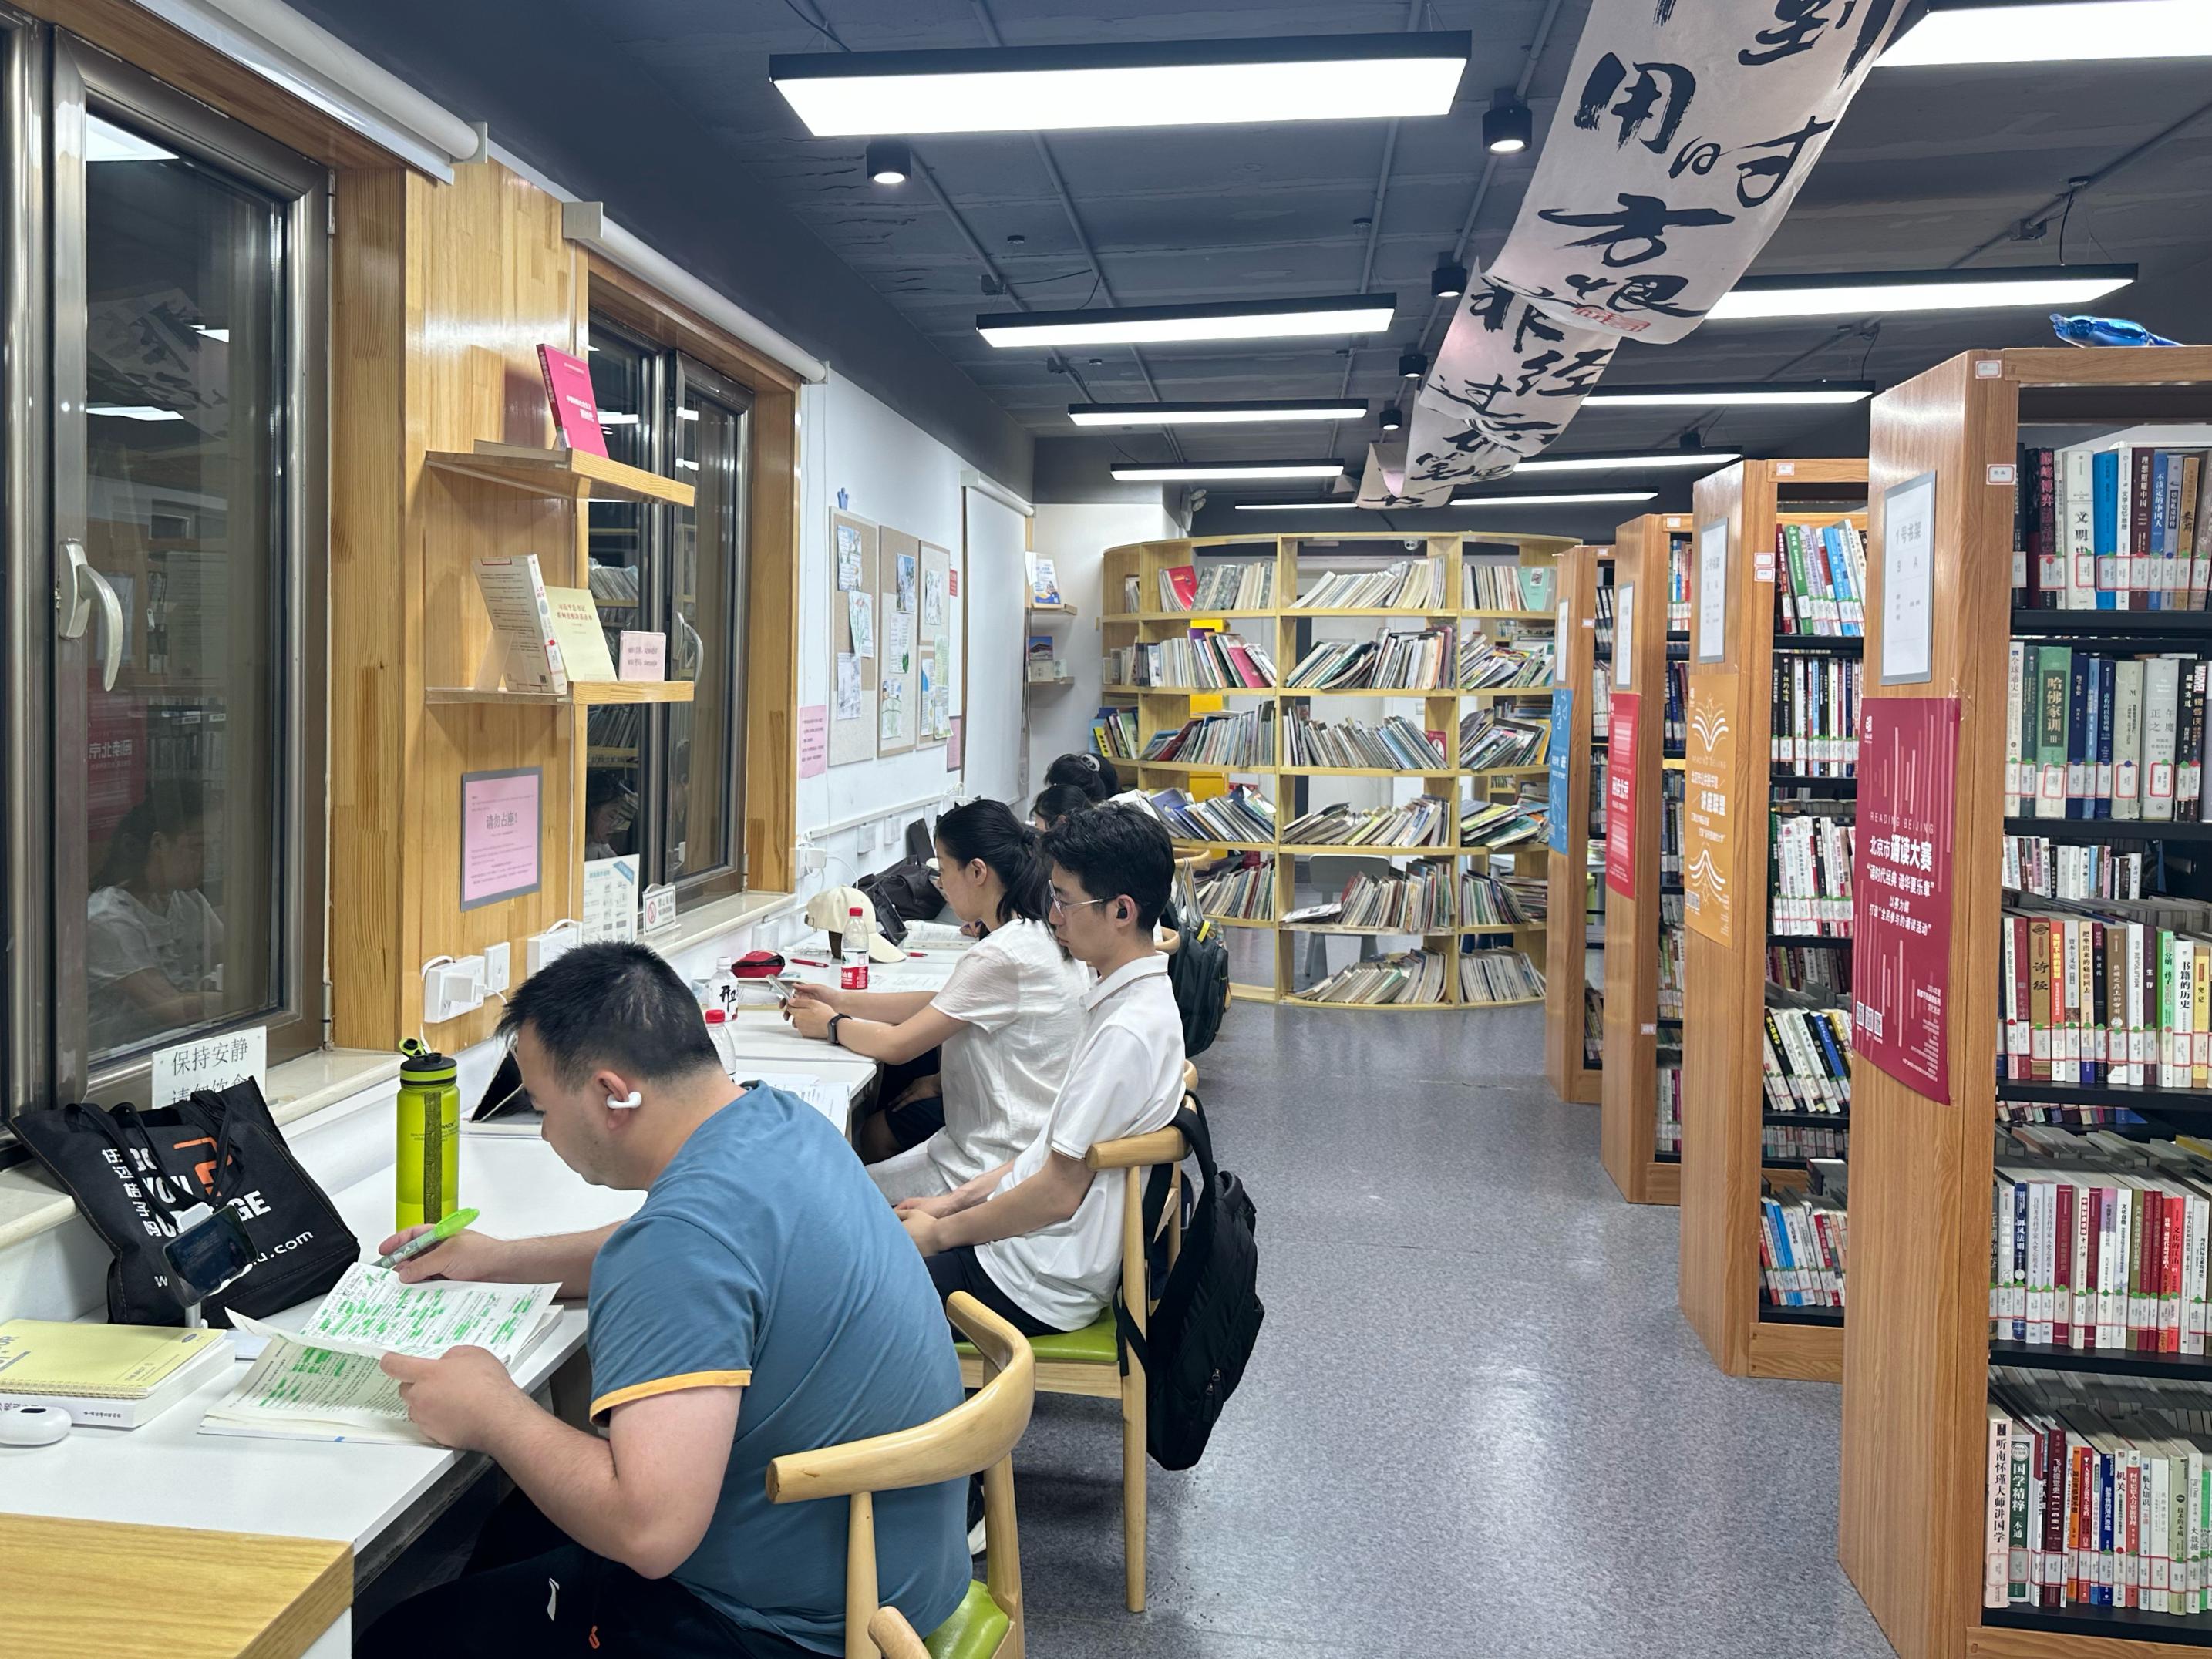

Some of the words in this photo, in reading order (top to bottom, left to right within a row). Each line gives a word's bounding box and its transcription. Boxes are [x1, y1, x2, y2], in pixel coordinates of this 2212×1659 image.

[2046, 676, 2062, 732] 哈佛家训
[1870, 833, 1932, 873] 北京市诵读大赛
[2180, 961, 2191, 1010] 书籍的历史
[173, 1037, 248, 1076] 保持安静
[2171, 1226, 2180, 1265] 文化的江山
[1993, 1439, 2007, 1543] 听南怀瑾大师讲国学
[2012, 1462, 2026, 1538] 国学精粹一本通
[2116, 1470, 2126, 1492] 机关
